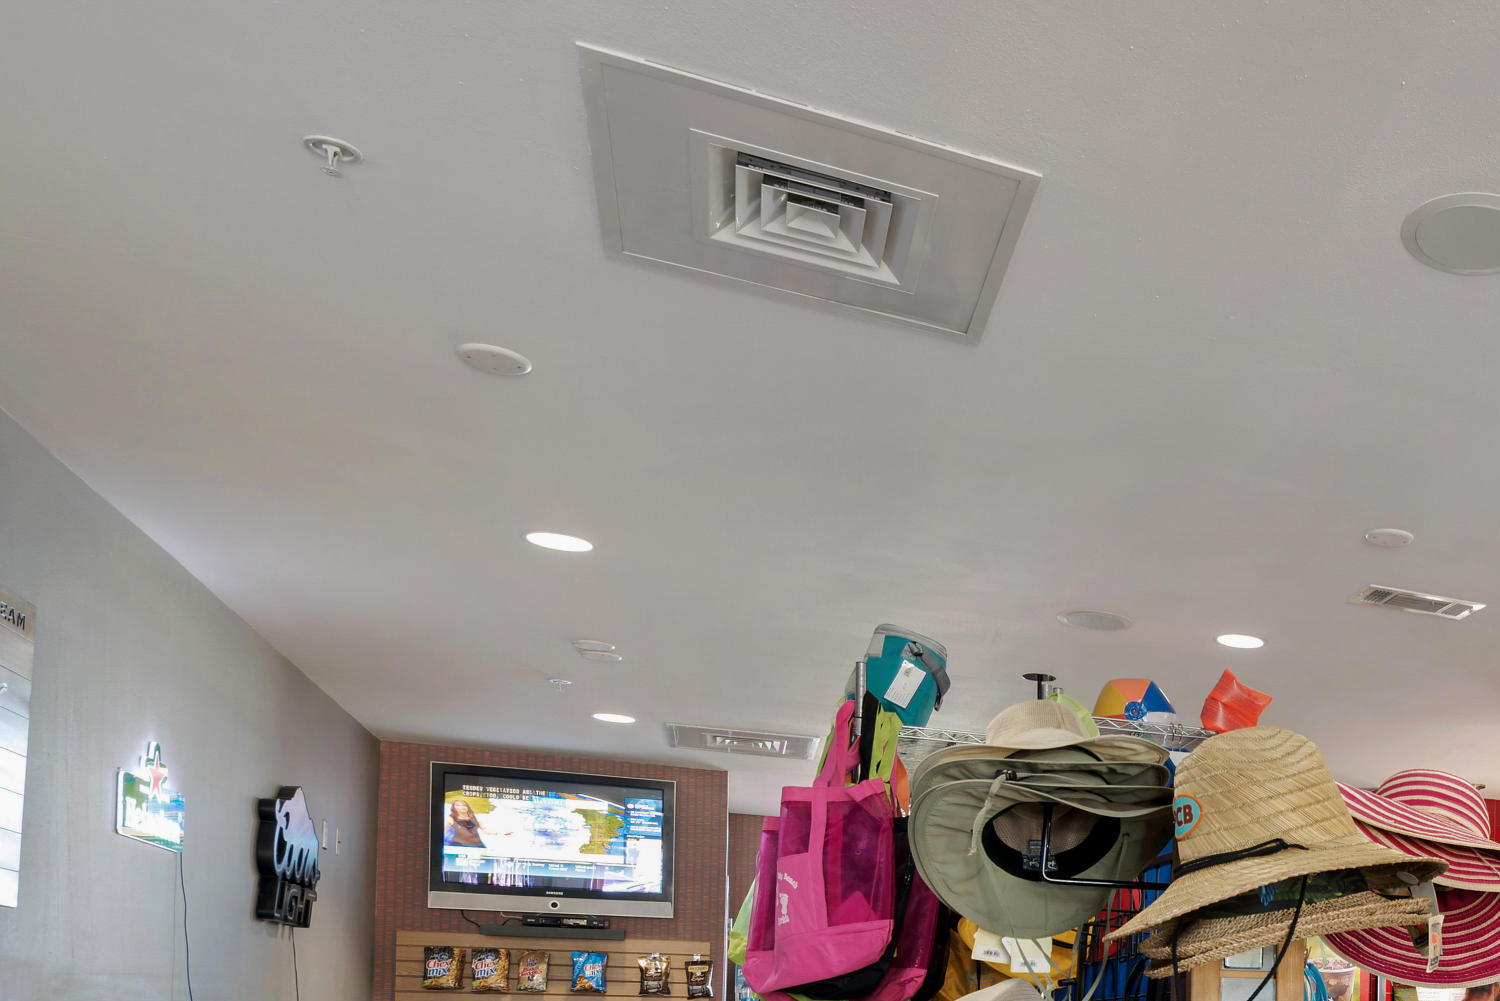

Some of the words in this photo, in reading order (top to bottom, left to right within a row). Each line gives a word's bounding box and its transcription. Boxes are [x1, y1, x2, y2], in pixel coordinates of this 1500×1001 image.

[1174, 804, 1194, 827] CB
[427, 959, 452, 968] Chex
[474, 959, 498, 969] Chex
[428, 967, 449, 976] mix
[476, 968, 495, 977] mix
